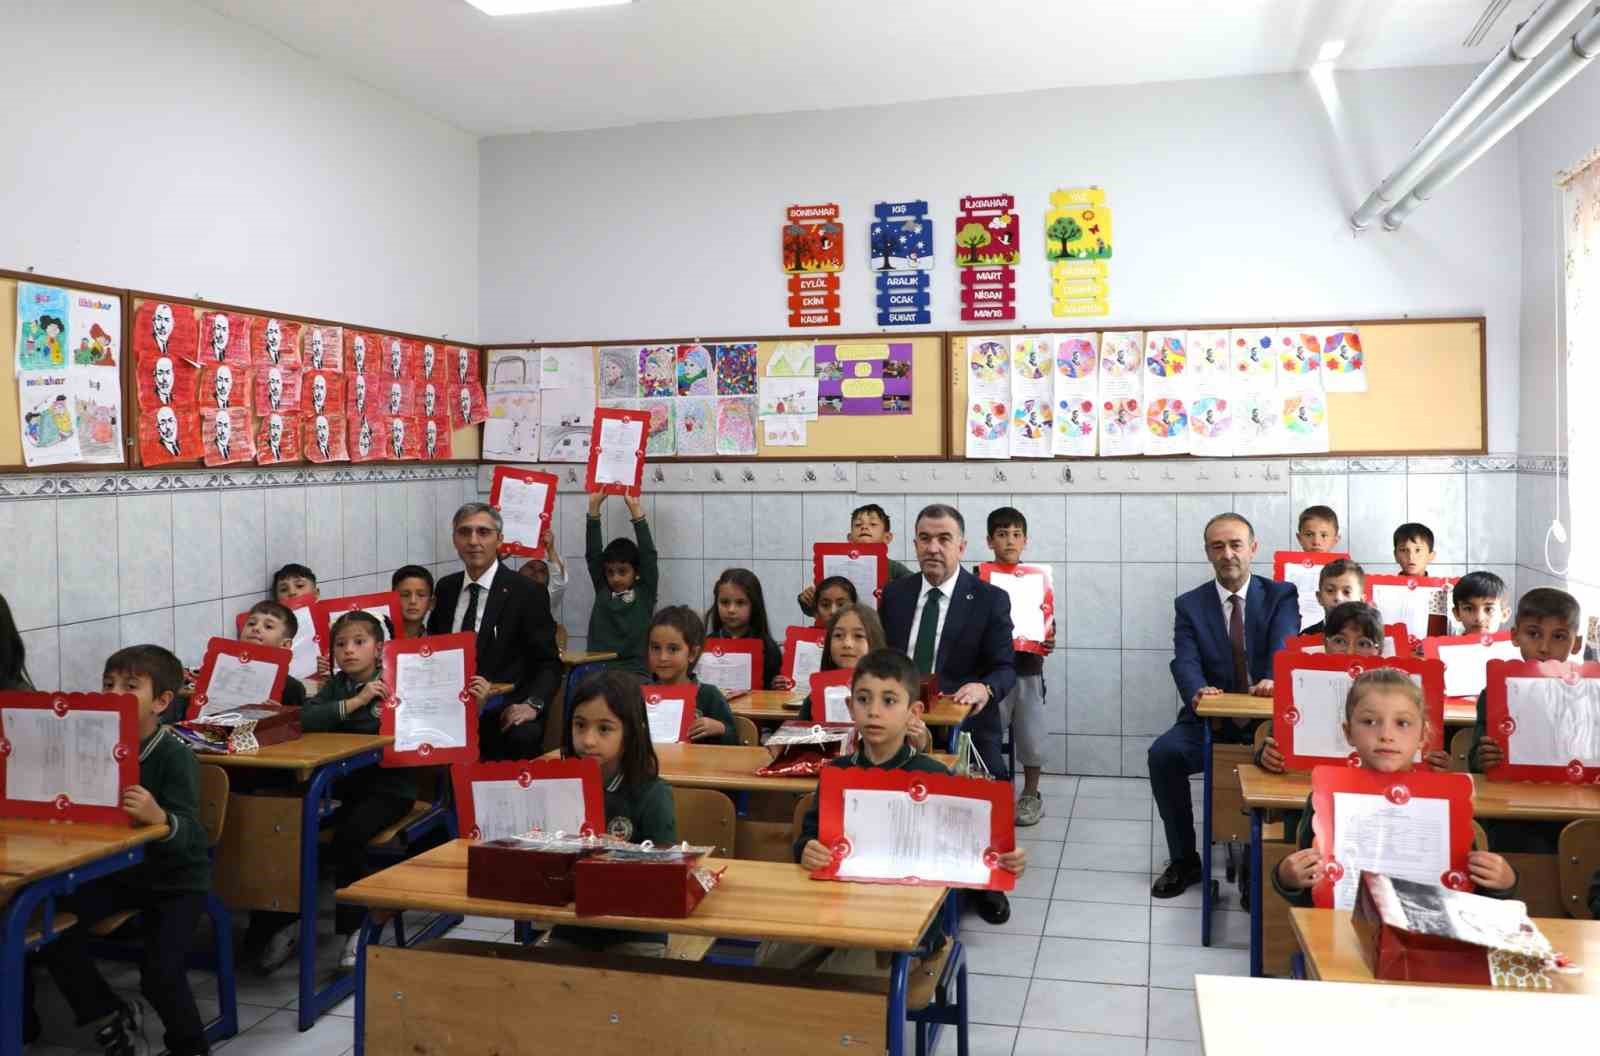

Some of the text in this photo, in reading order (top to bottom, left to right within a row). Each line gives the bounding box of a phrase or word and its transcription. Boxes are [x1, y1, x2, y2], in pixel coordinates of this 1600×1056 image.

[976, 272, 1003, 281] MART
[887, 277, 919, 286] ARALIK
[890, 295, 914, 304] OCAK
